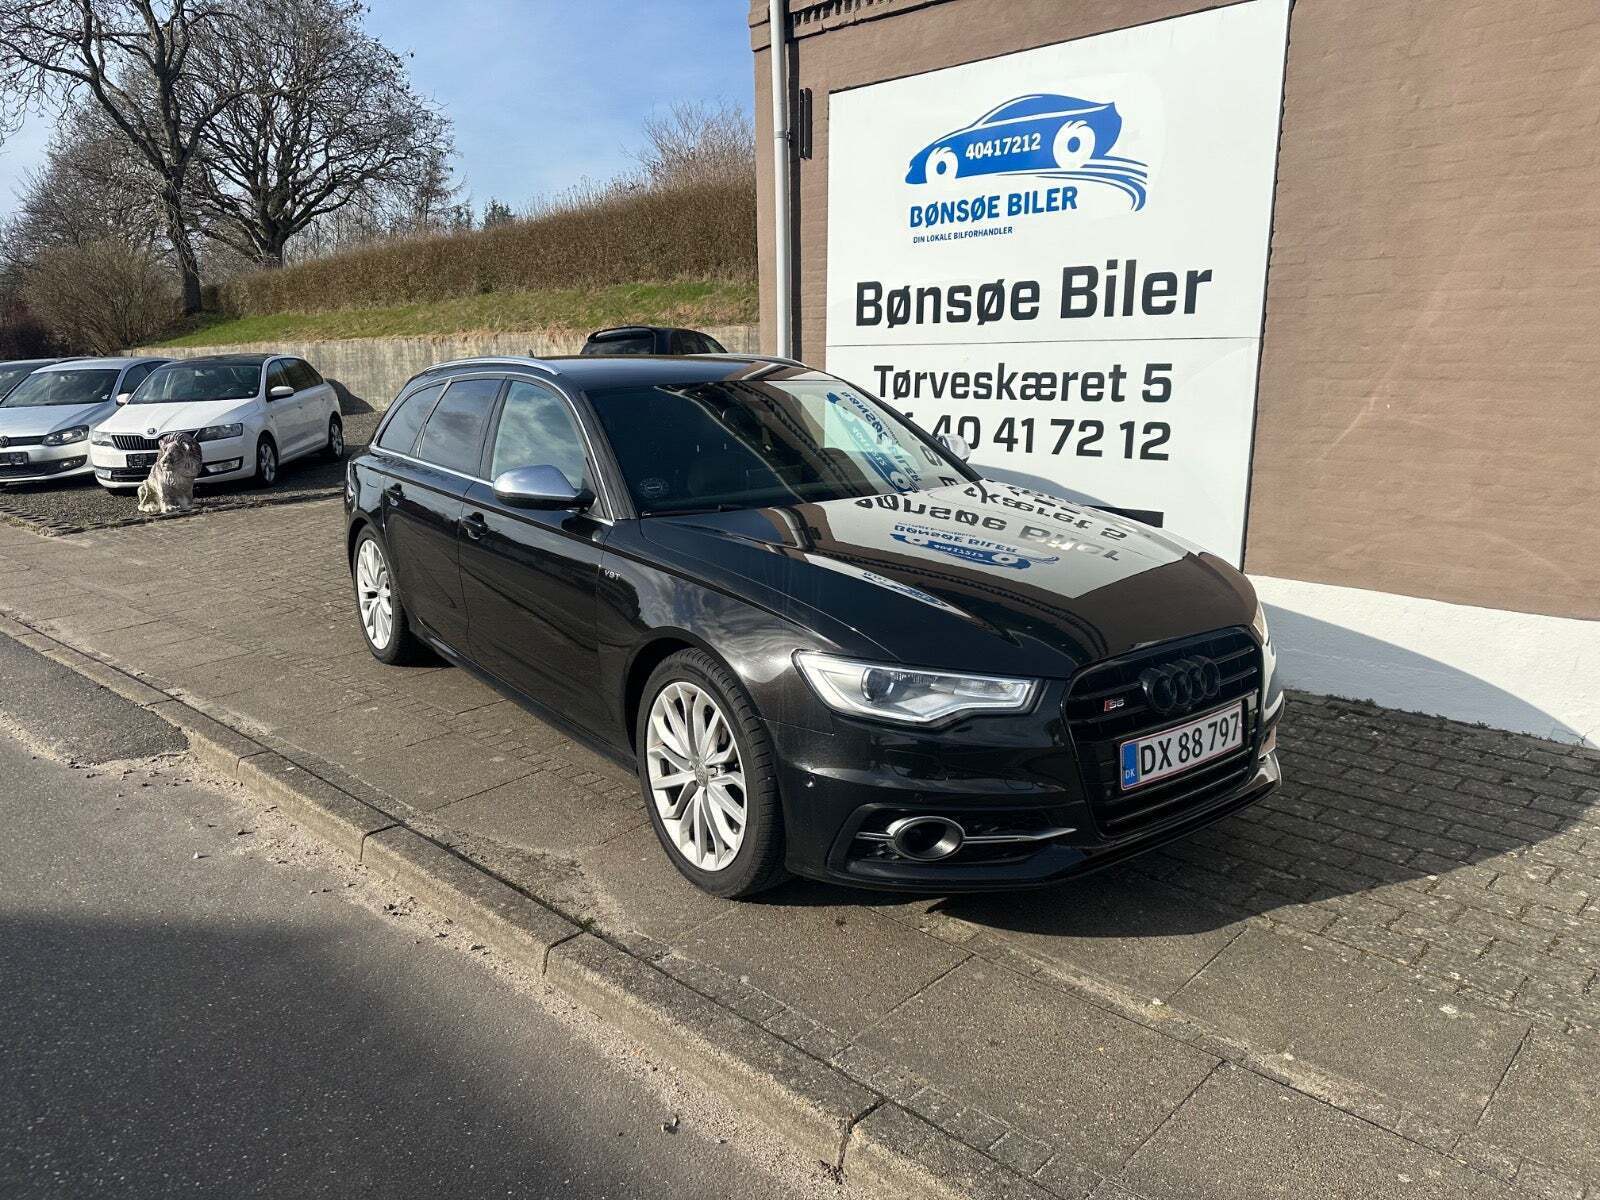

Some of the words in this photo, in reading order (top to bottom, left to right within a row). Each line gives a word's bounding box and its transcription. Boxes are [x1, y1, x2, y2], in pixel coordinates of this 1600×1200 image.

[965, 132, 1042, 160] 40417212
[909, 195, 1001, 229] BØNSØE
[1007, 186, 1078, 217] BILER
[913, 235, 925, 244] DIN
[926, 232, 952, 243] LOKALE
[953, 226, 1013, 240] BILFORHANDLER
[855, 278, 1041, 329] Bønsøe
[1060, 259, 1213, 319] Biler
[873, 362, 1127, 403] Tørveskæret
[1141, 363, 1173, 403] 5
[992, 417, 1035, 454] 41
[1050, 418, 1105, 458] 72
[1119, 420, 1171, 461] 12
[1140, 737, 1173, 776] DX
[1178, 727, 1203, 764] 88
[1207, 711, 1240, 751] 797
[1125, 768, 1136, 780] DK
